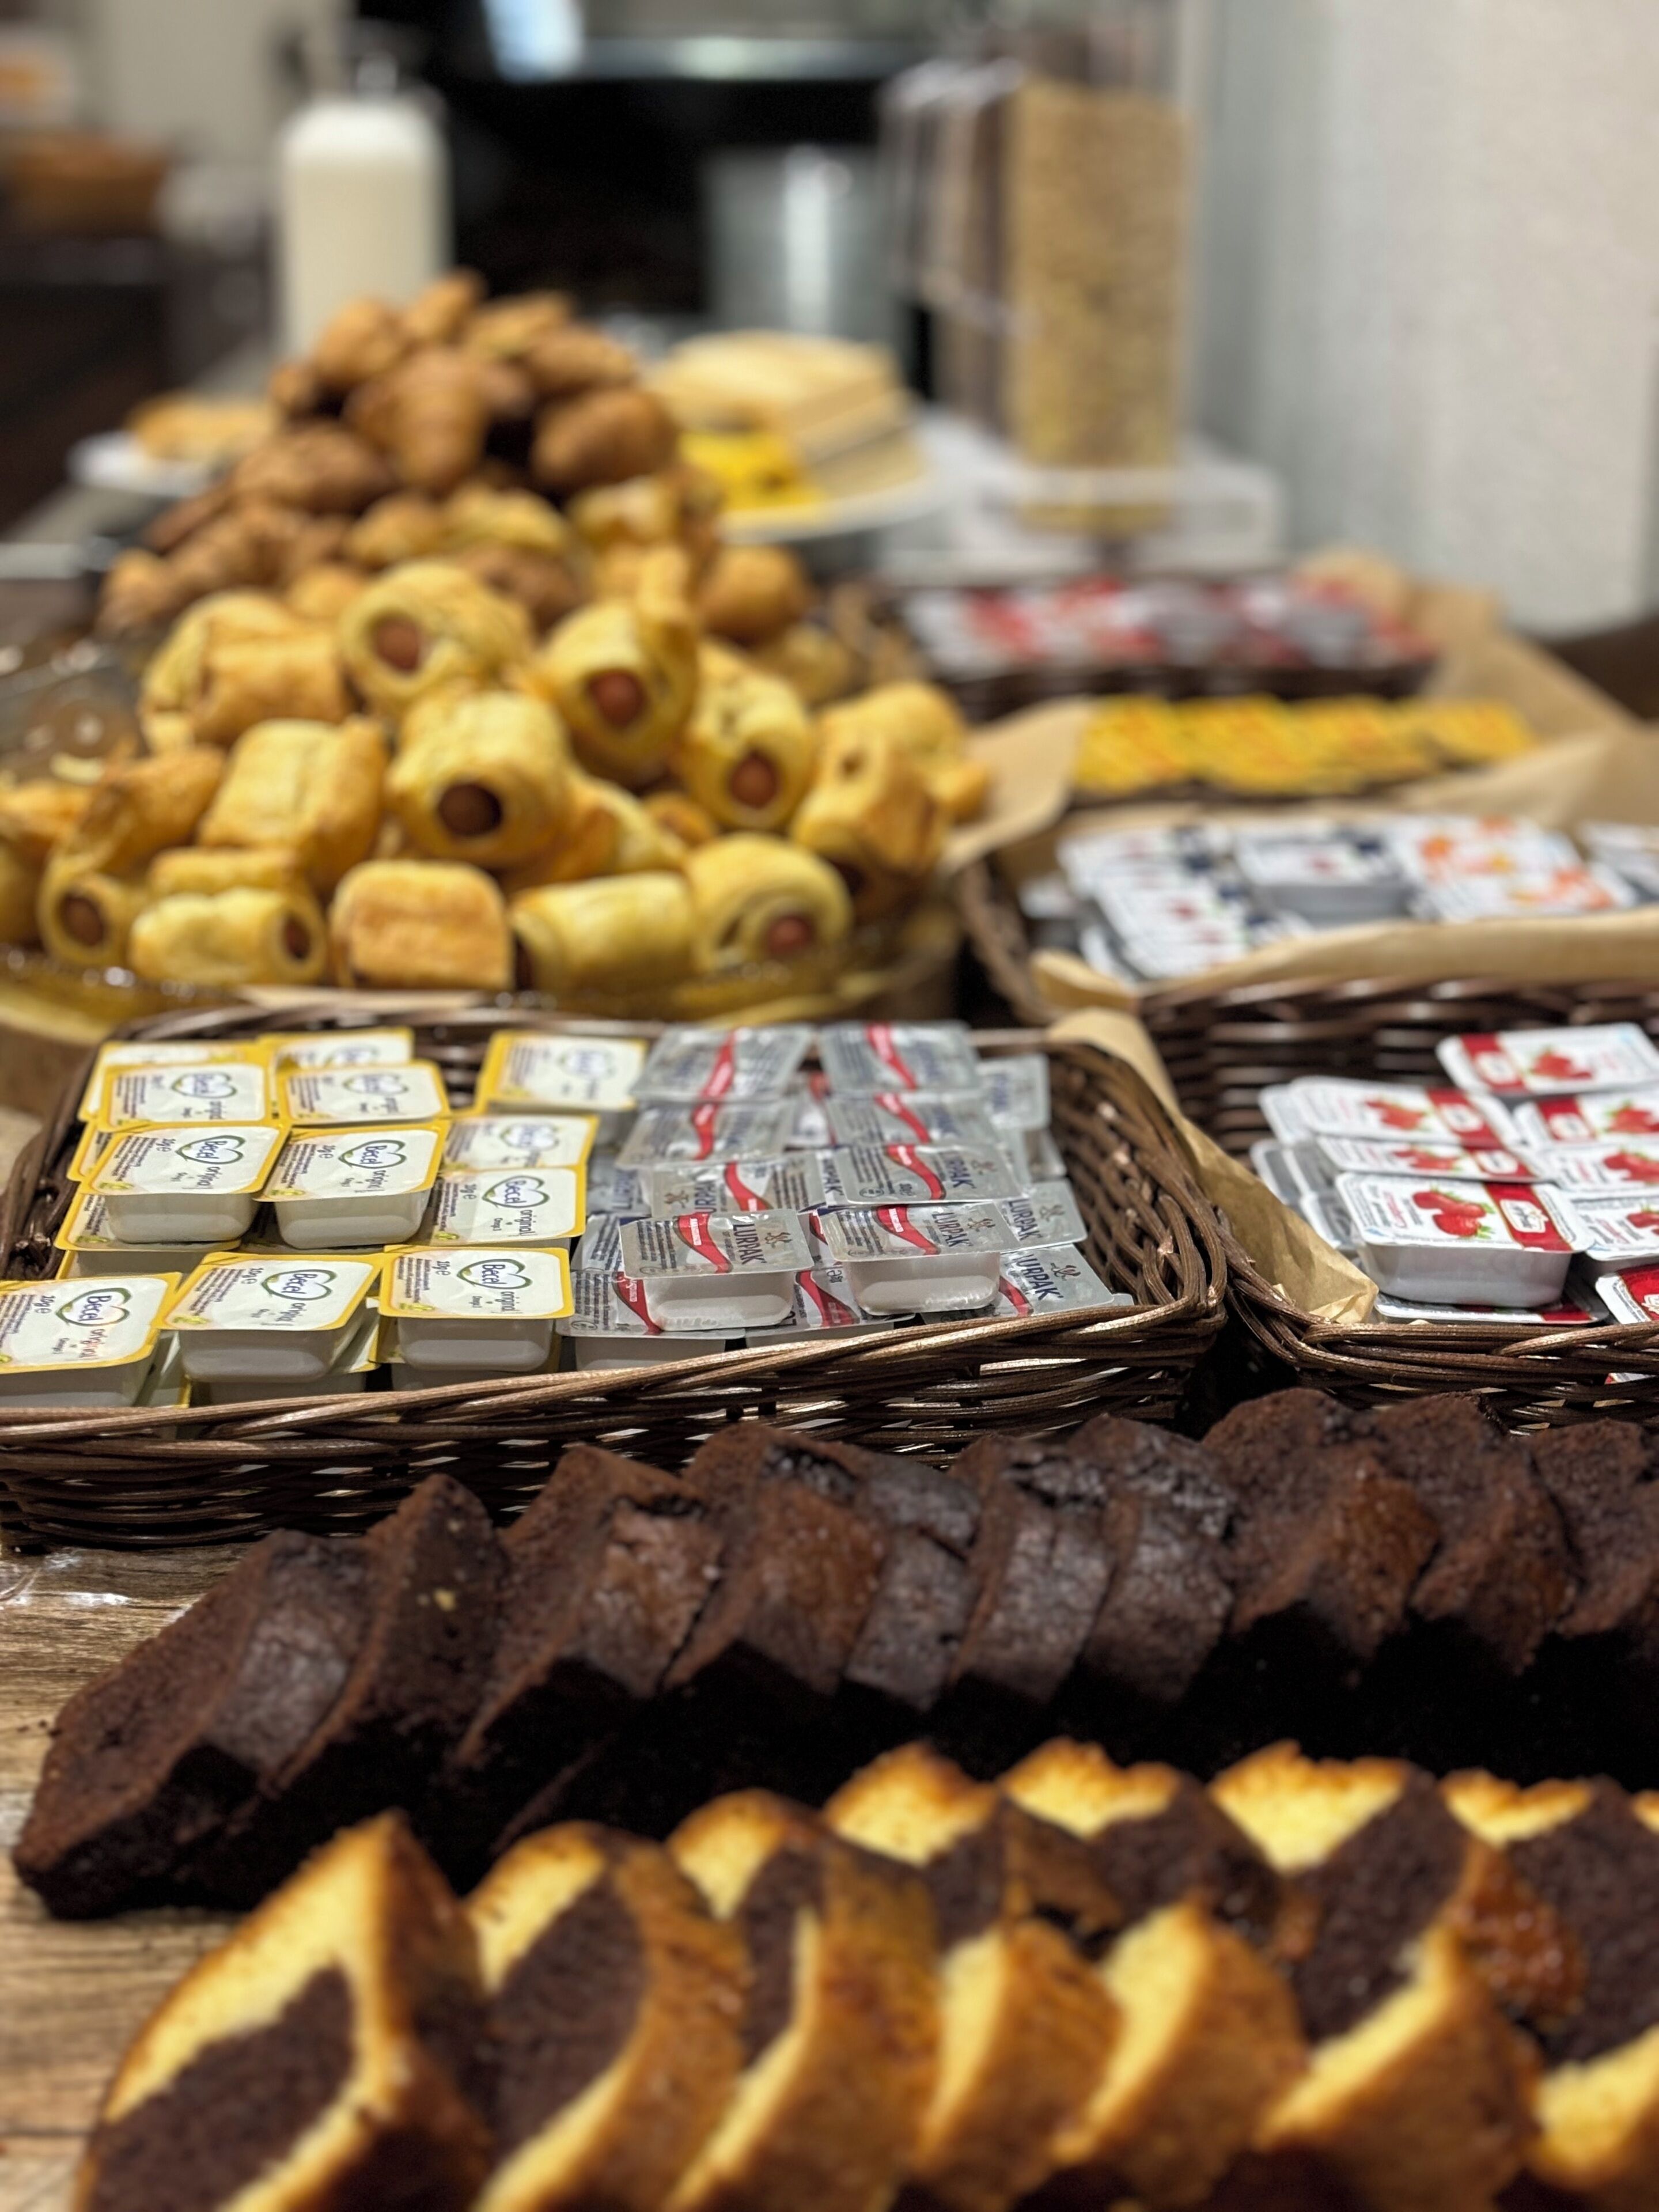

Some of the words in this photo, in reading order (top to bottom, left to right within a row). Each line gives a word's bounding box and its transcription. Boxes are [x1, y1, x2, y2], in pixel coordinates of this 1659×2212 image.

[195, 1140, 228, 1160] Becel
[359, 1145, 388, 1165] Becel
[940, 1152, 974, 1188] RPAK
[505, 1180, 527, 1204] Becel
[514, 1209, 537, 1236] original
[931, 1212, 971, 1247] LURPAK
[1009, 1199, 1041, 1241] LURPAK
[732, 1224, 765, 1265] LURPAK
[281, 1273, 317, 1294] Becel
[482, 1264, 507, 1285] Becel
[78, 1295, 112, 1321] Becel
[495, 1291, 520, 1312] original
[79, 1328, 108, 1358] original
